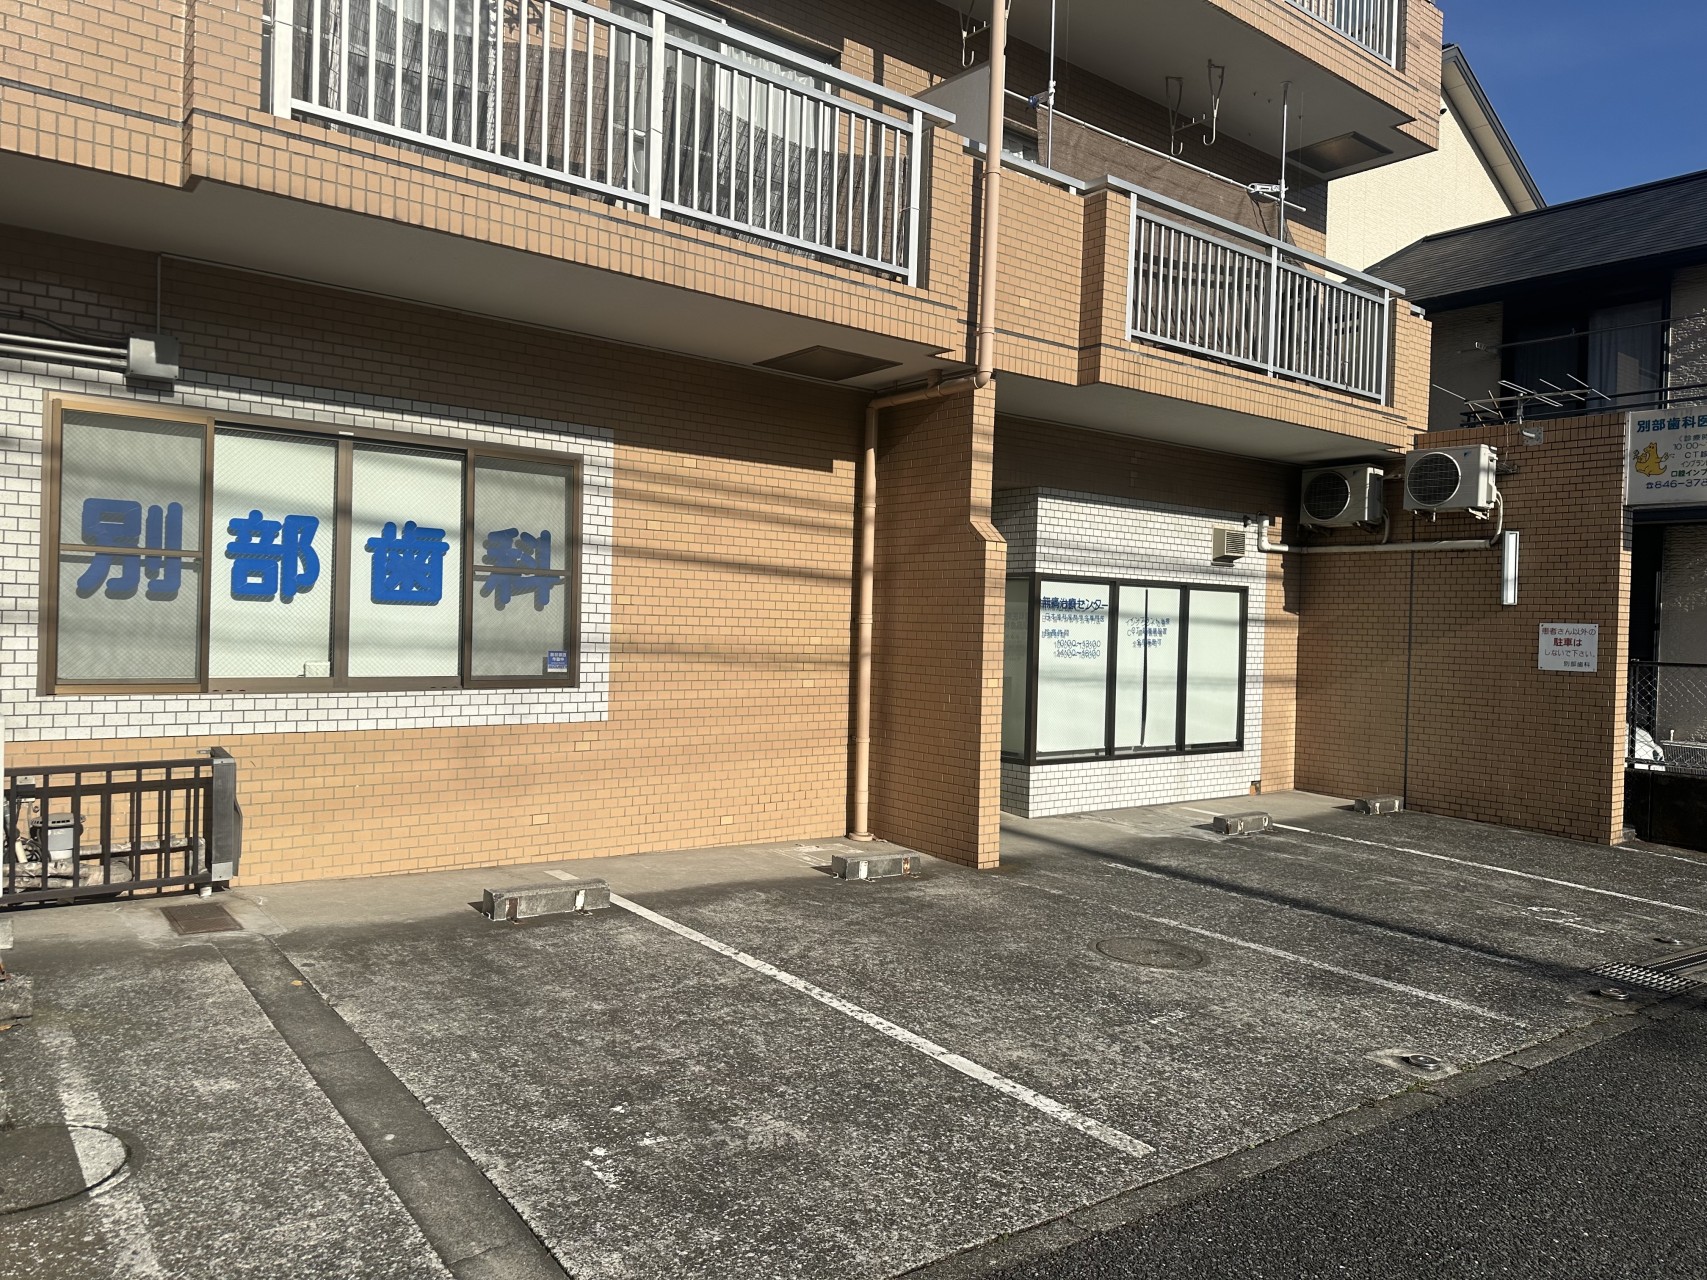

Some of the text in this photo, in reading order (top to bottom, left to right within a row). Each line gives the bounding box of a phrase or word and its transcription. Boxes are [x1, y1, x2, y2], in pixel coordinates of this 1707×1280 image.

[76, 497, 554, 611] 別部歯科
[1553, 638, 1583, 647] 駐車は
